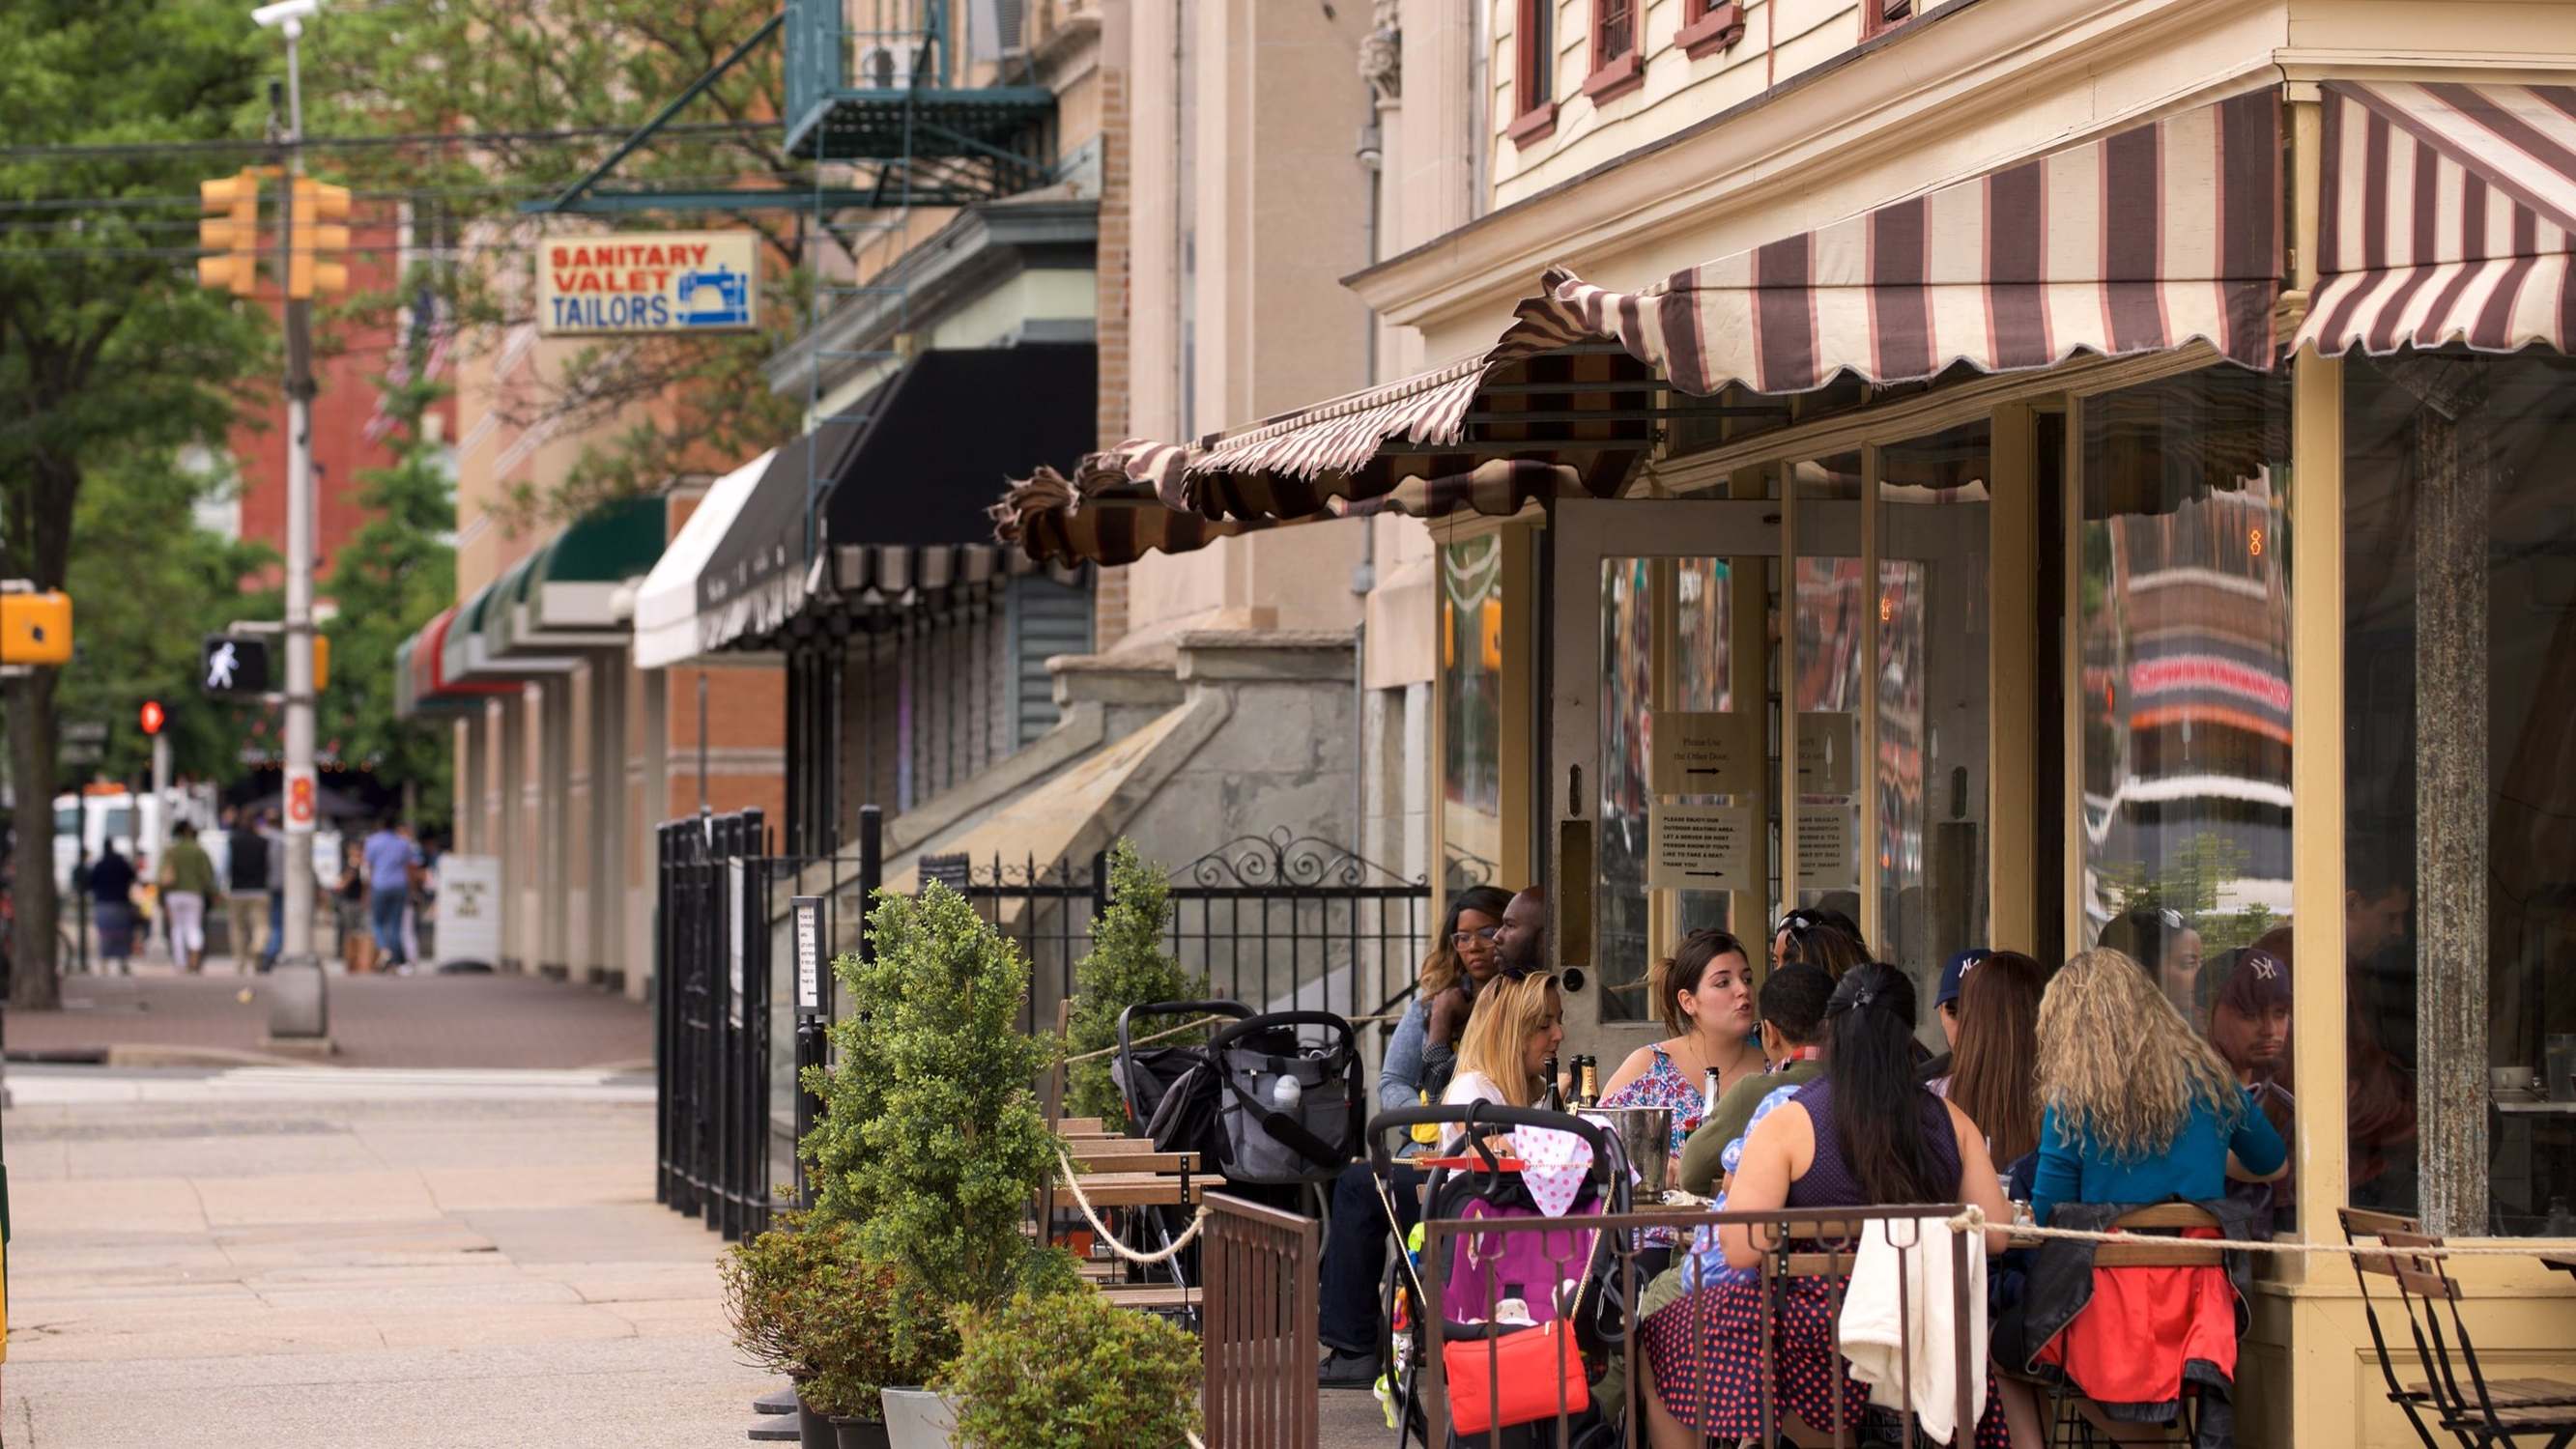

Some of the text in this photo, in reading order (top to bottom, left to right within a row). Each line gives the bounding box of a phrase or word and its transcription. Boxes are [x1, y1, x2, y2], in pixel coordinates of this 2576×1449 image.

[551, 243, 709, 268] SANITARY
[553, 270, 672, 293] VALET
[552, 295, 669, 327] TAILORS
